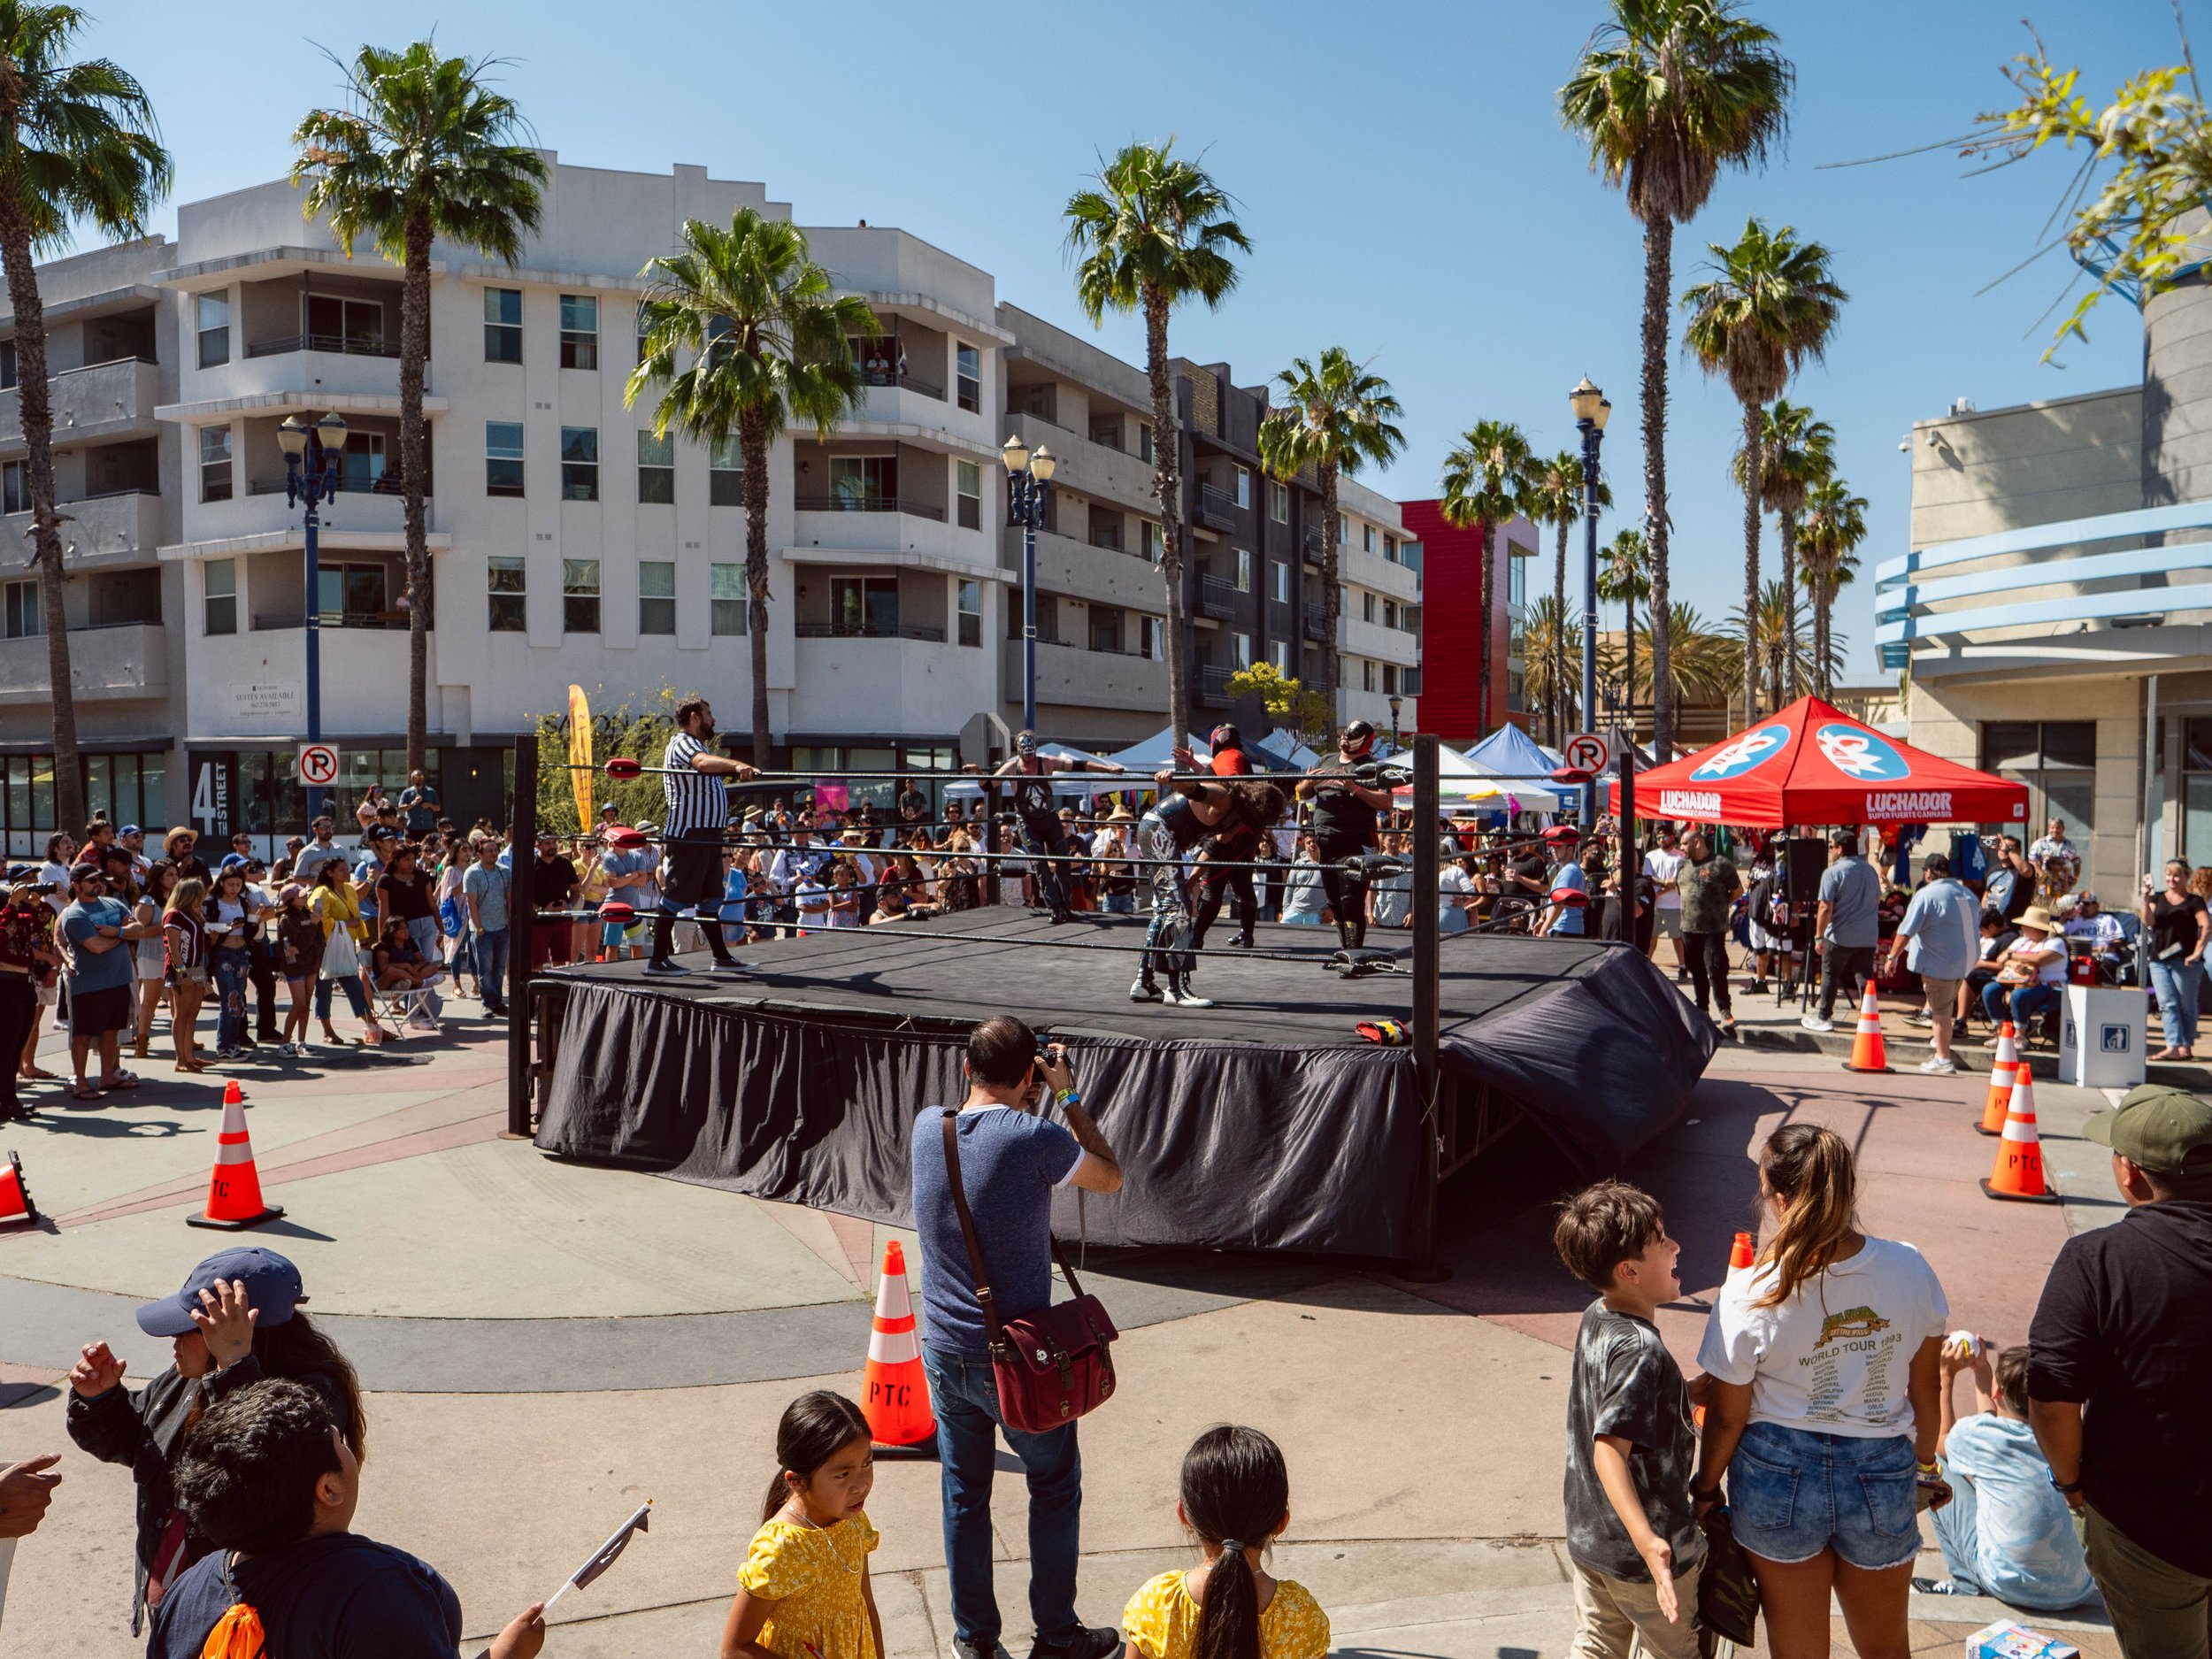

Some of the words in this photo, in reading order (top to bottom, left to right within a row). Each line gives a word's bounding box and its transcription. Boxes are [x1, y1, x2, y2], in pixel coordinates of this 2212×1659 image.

[192, 763, 216, 836] 4
[216, 762, 227, 820] STREET
[1661, 790, 1721, 811] LUCHADOR
[1866, 792, 1952, 812] LUCHADOR
[2008, 1155, 2038, 1171] PTC
[1799, 1348, 1839, 1366] WORLD
[1842, 1340, 1877, 1353] TOUR
[1880, 1333, 1902, 1348] 1993
[870, 1381, 910, 1407] PTC
